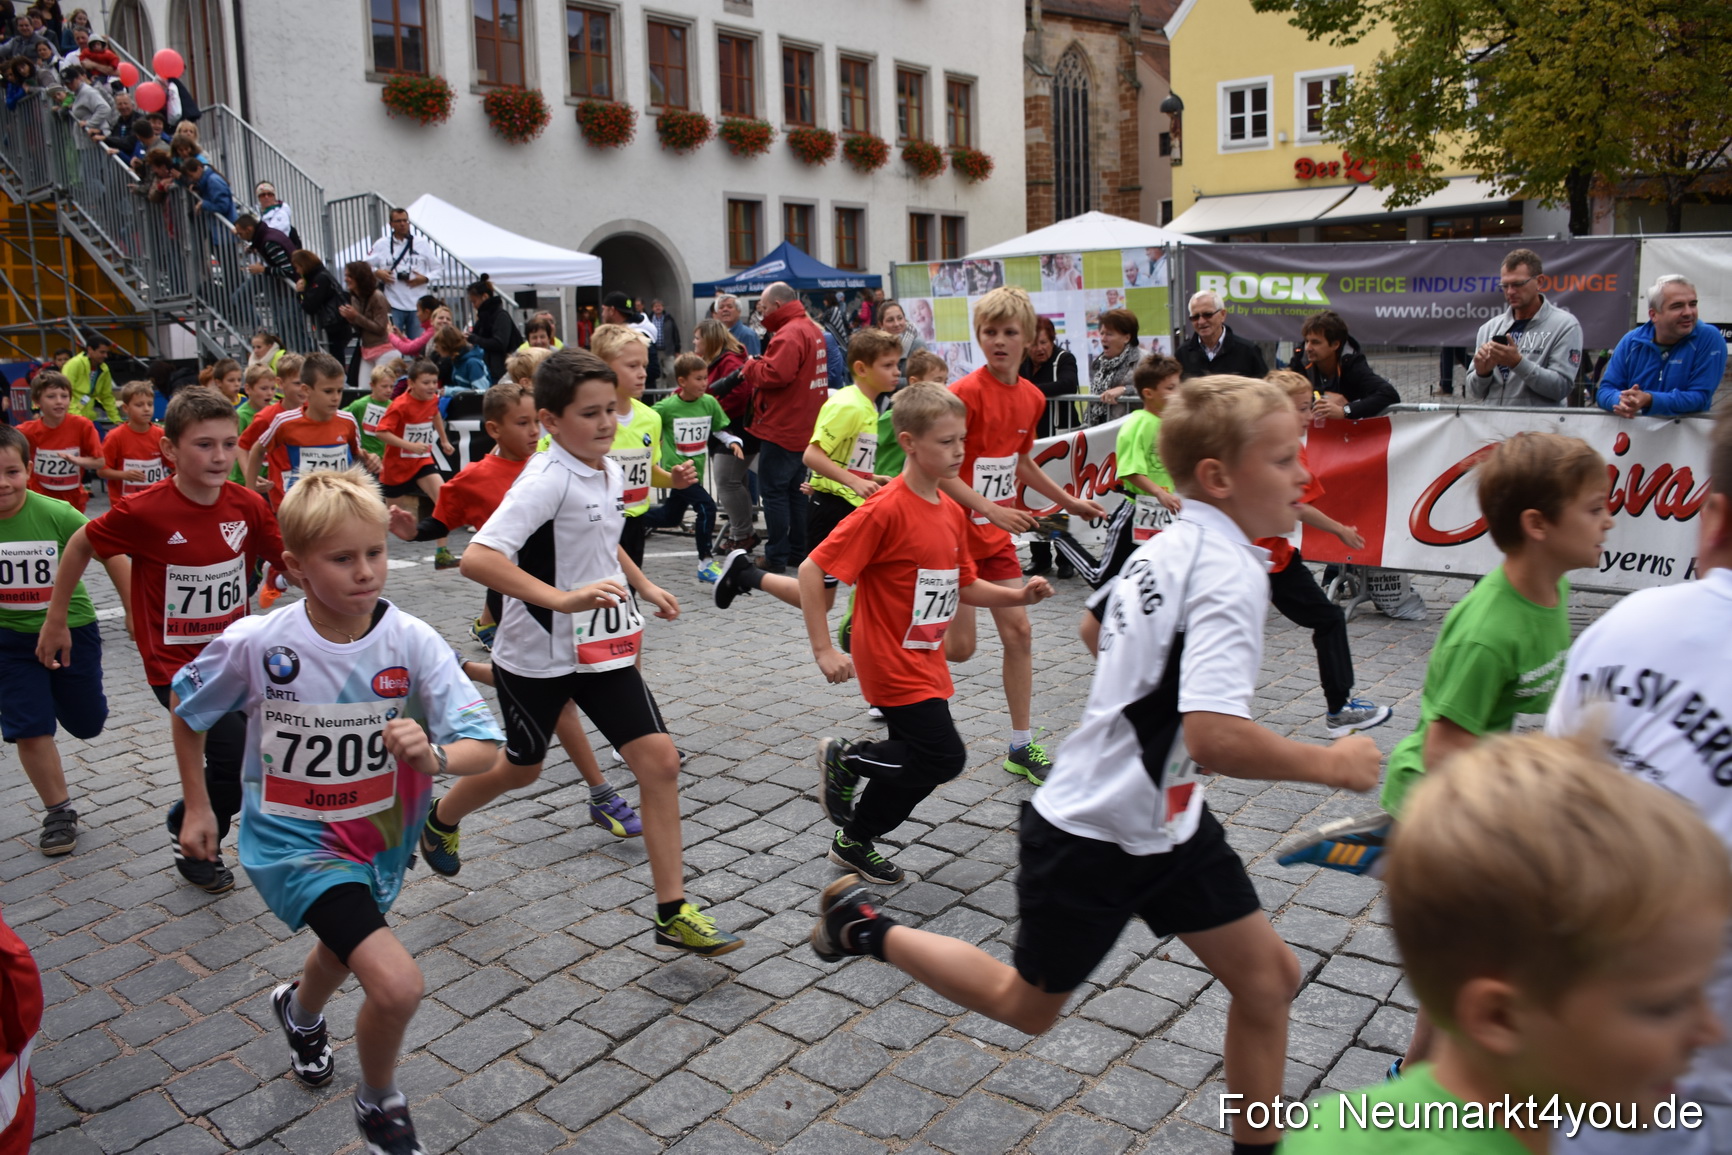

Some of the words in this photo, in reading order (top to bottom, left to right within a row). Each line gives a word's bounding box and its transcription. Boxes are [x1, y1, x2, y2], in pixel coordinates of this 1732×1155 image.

[1294, 157, 1339, 180] Der
[1198, 272, 1328, 303] BOCK
[1340, 277, 1406, 294] OFFICE
[1412, 276, 1502, 293] INDUSTR
[1537, 274, 1618, 292] OUNGE
[1252, 306, 1282, 316] smart
[679, 426, 708, 441] 7137
[37, 459, 77, 475] 7222
[1, 548, 43, 556] Neumarkt
[1600, 549, 1675, 578] yerns
[169, 573, 202, 582] PARTL
[204, 566, 240, 581] Neumarkt
[177, 575, 242, 614] 7166
[610, 641, 634, 655] Luis
[266, 686, 300, 702] PARTL
[266, 710, 311, 728] PARTL
[314, 714, 382, 728] Neumarkt
[276, 729, 389, 778] 7209
[305, 789, 359, 807] Jonas
